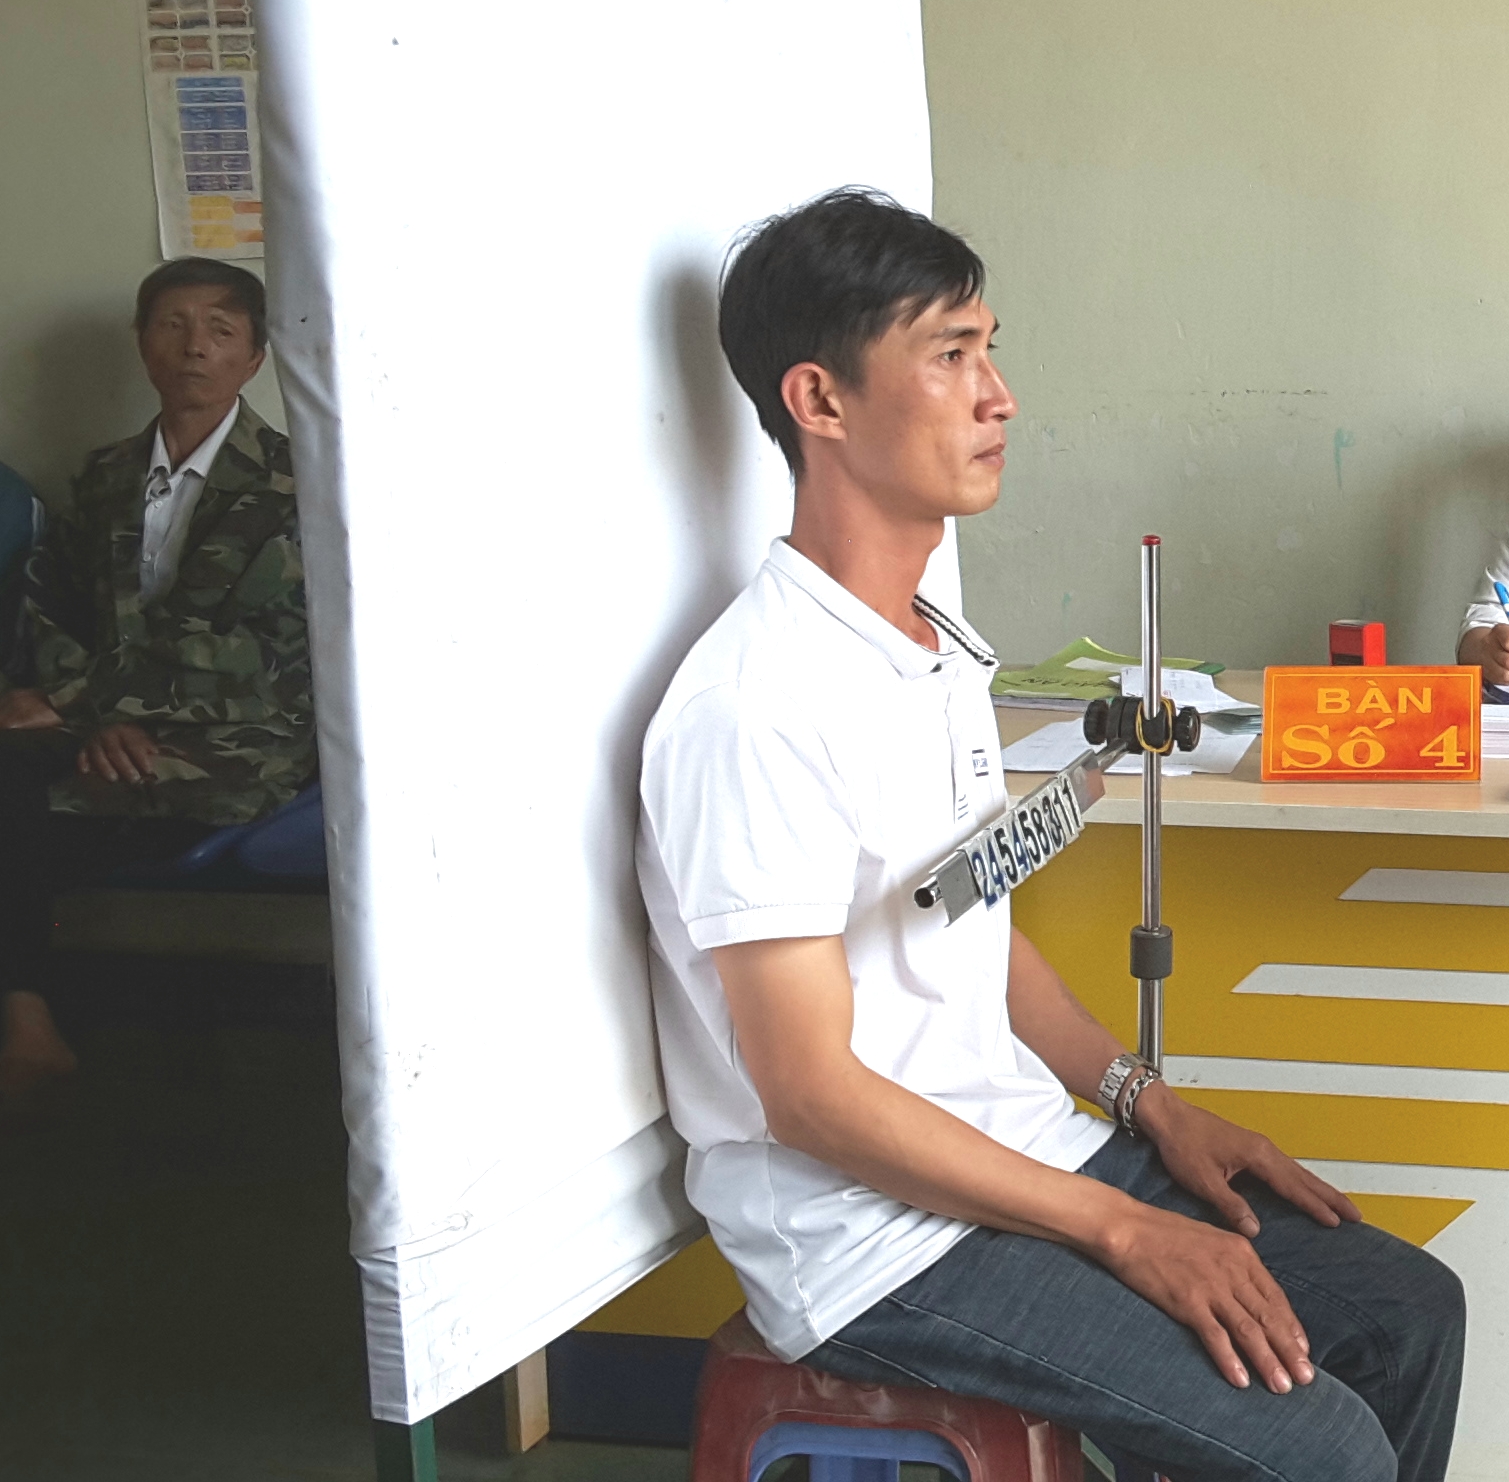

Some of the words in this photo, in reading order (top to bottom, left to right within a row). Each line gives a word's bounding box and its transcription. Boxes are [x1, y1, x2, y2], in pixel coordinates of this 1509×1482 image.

[1317, 680, 1432, 714] BÀN
[1281, 717, 1396, 769] Số
[1419, 725, 1466, 767] 4
